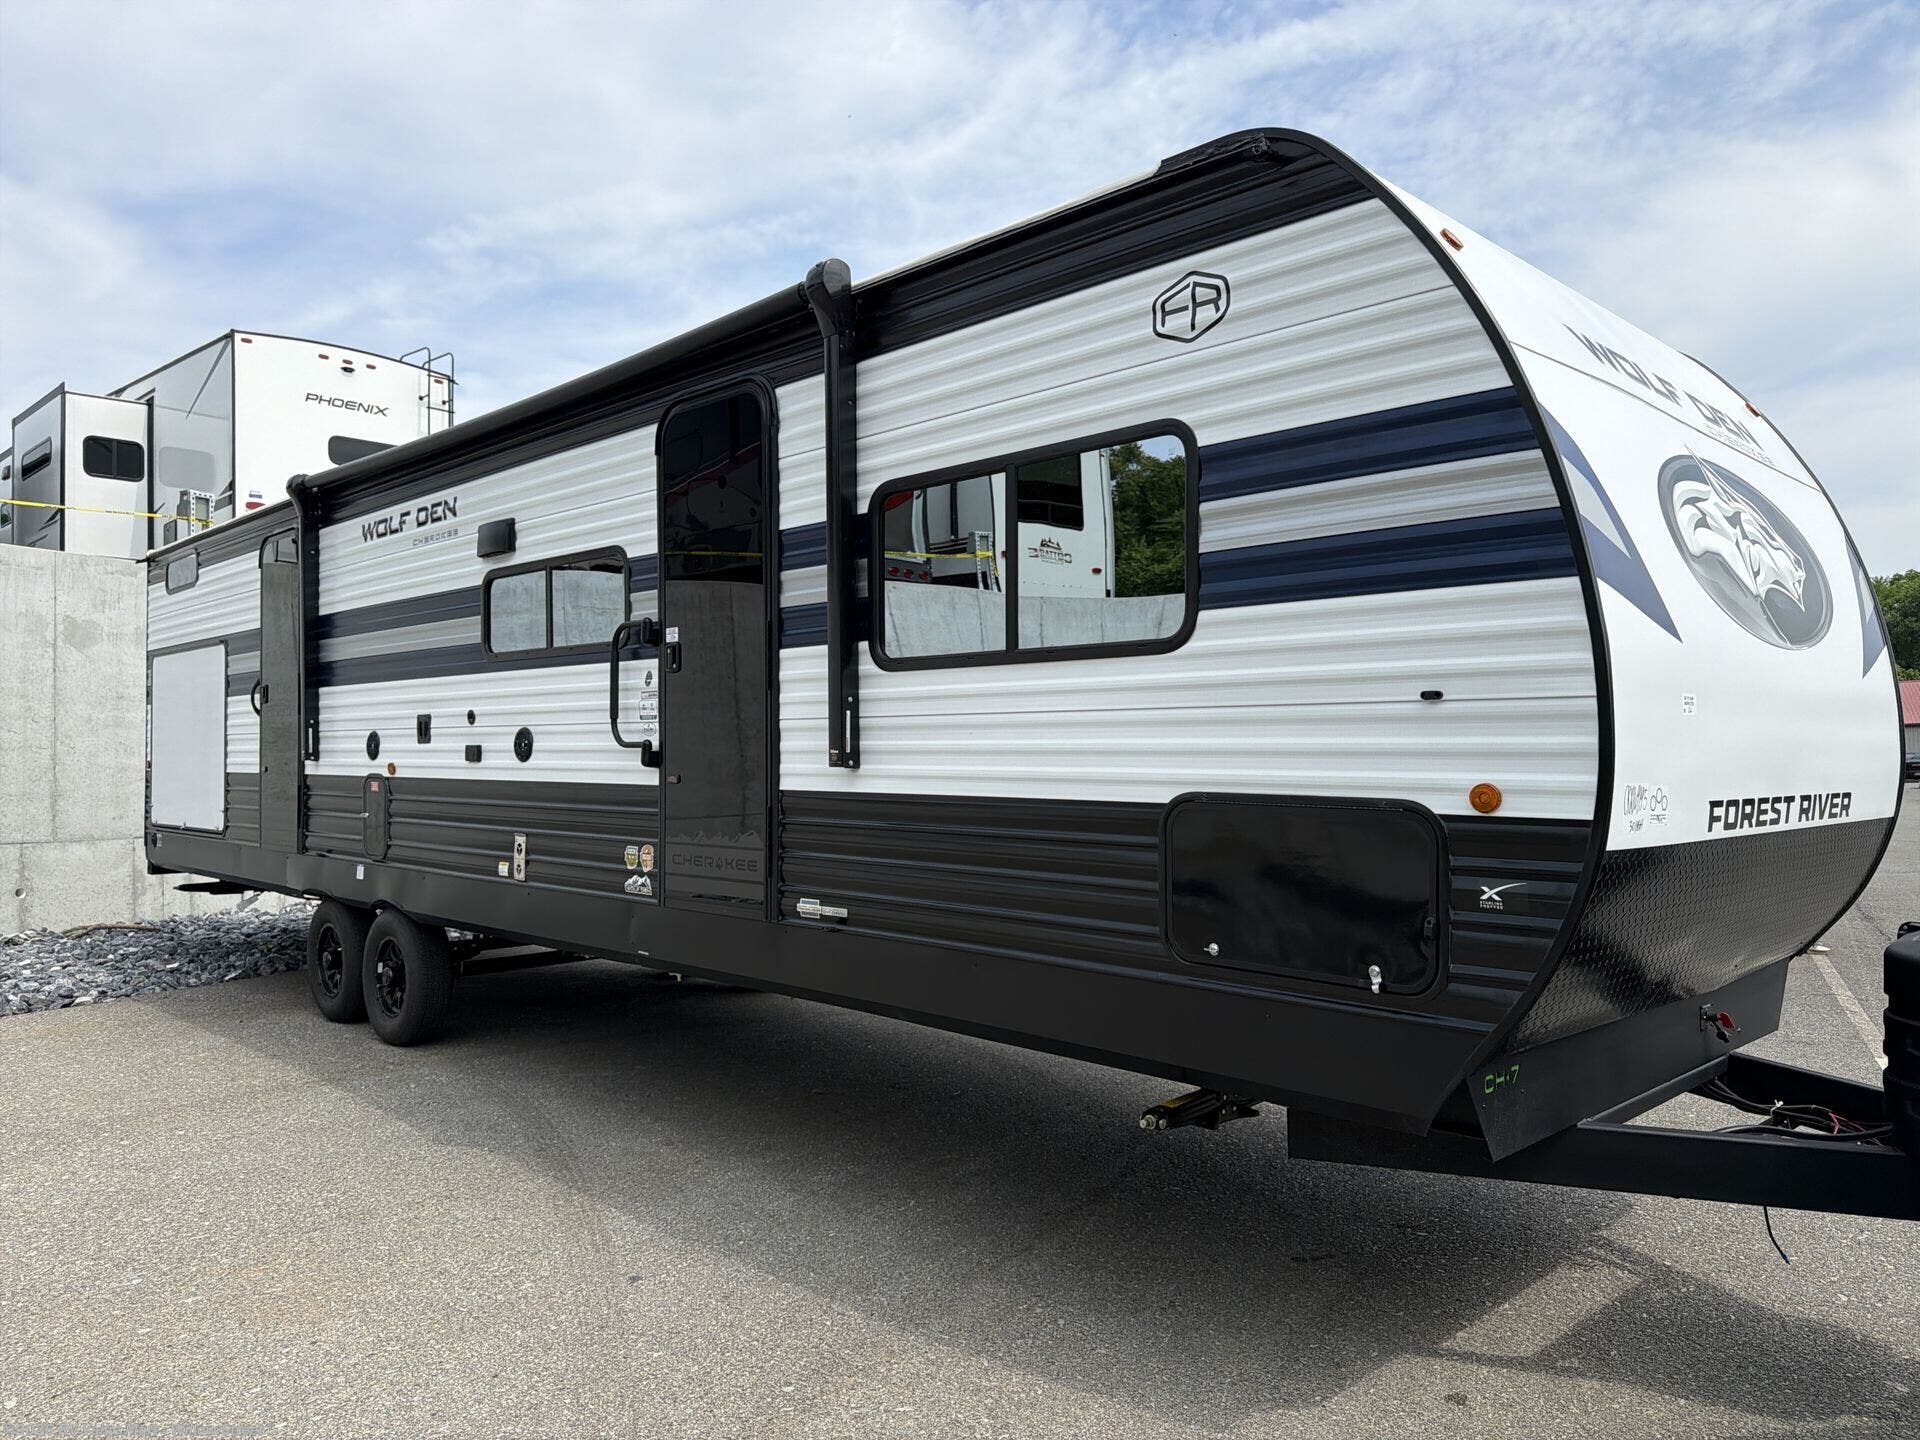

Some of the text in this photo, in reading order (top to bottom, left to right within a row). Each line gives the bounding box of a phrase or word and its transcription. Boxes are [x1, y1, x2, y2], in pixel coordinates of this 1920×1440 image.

[1161, 281, 1222, 332] FR
[305, 392, 389, 417] PHOENIX
[1562, 323, 1682, 408] WOLF
[1683, 390, 1765, 452] DEN
[362, 496, 458, 543] WOLF DEN
[1707, 791, 1852, 833] FOREST RIVER
